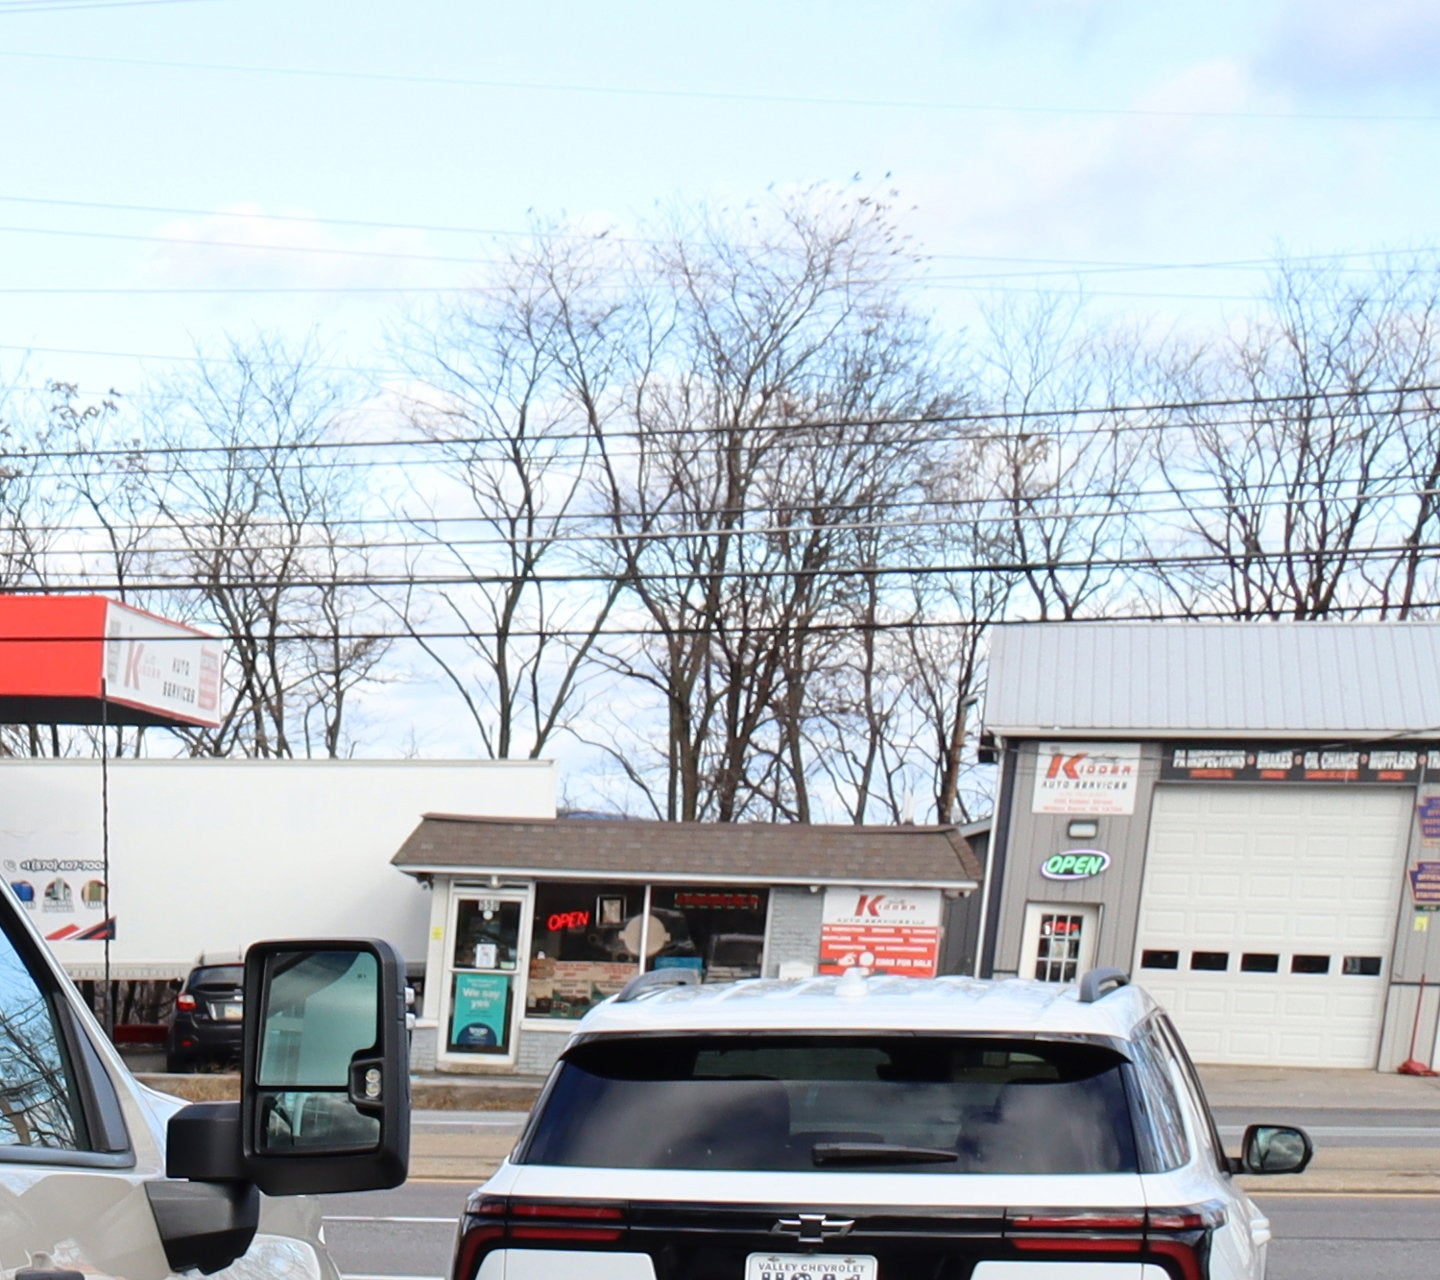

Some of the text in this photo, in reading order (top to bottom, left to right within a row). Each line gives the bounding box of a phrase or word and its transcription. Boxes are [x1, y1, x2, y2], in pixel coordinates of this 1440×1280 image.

[1042, 780, 1070, 789] AUTO
[1046, 855, 1104, 875] OPEN
[548, 911, 591, 931] OPEN
[758, 1263, 866, 1273] VALLEY CHEVROLET
